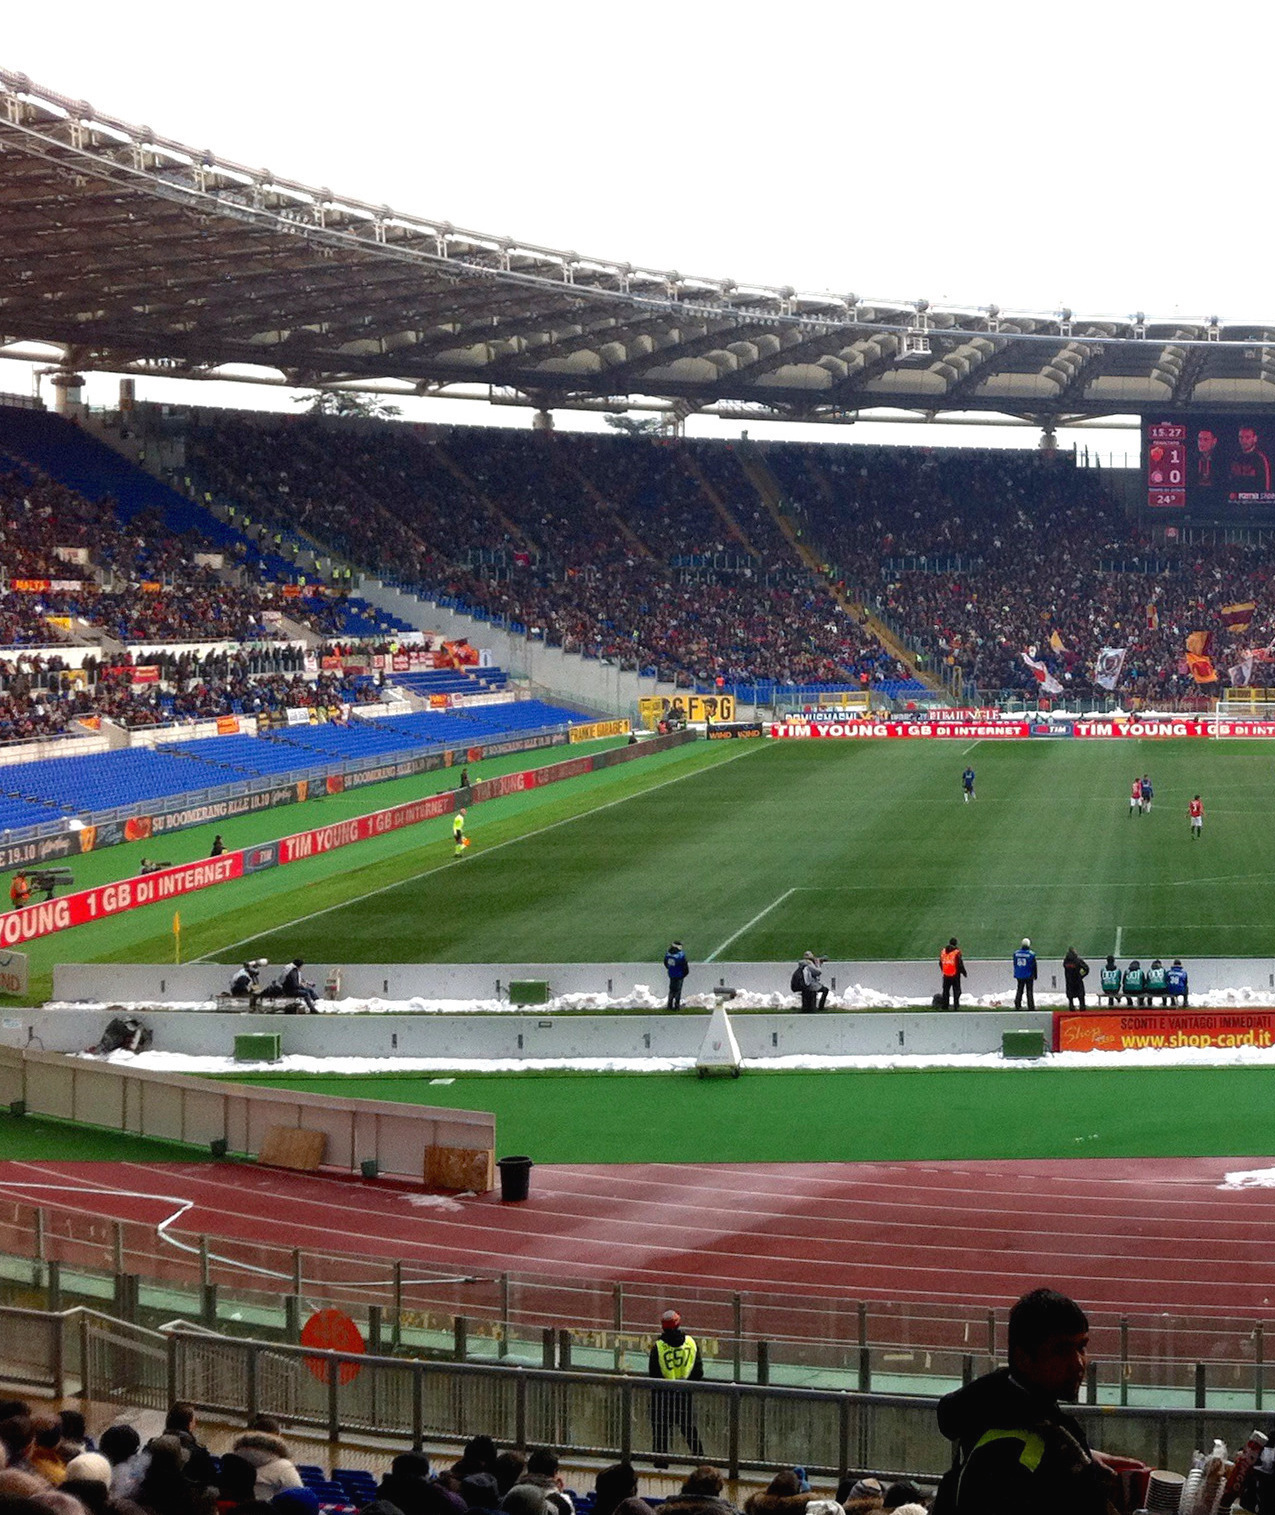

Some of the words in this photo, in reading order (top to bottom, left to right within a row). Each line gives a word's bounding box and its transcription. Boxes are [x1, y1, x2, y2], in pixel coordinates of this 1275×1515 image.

[1170, 450, 1180, 463] 1
[1169, 470, 1181, 483] 0
[709, 731, 733, 740] WIND
[737, 729, 761, 739] WIND
[775, 724, 812, 737] TIM
[817, 724, 888, 737] YOUNG
[896, 726, 903, 736] 1
[907, 725, 933, 736] GB
[936, 726, 951, 735] DI
[954, 726, 1022, 735] INTERNET
[1076, 724, 1113, 736] TIM
[1118, 724, 1188, 736] YOUNG
[1194, 725, 1203, 735] 1
[1234, 726, 1250, 735] DI
[286, 837, 312, 861] TIM
[316, 821, 359, 851] YOUNG
[376, 813, 393, 832] GB
[86, 892, 97, 916] 1
[102, 883, 131, 912] GB
[136, 881, 154, 903] DI
[158, 858, 233, 896] INTERNET
[1120, 1017, 1158, 1030] SCONTI
[1159, 1017, 1166, 1029] E
[1169, 1016, 1217, 1029] VANTAGGI
[1219, 1015, 1272, 1029] IMMEDIATI
[1120, 1029, 1272, 1048] www.shop-card.it
